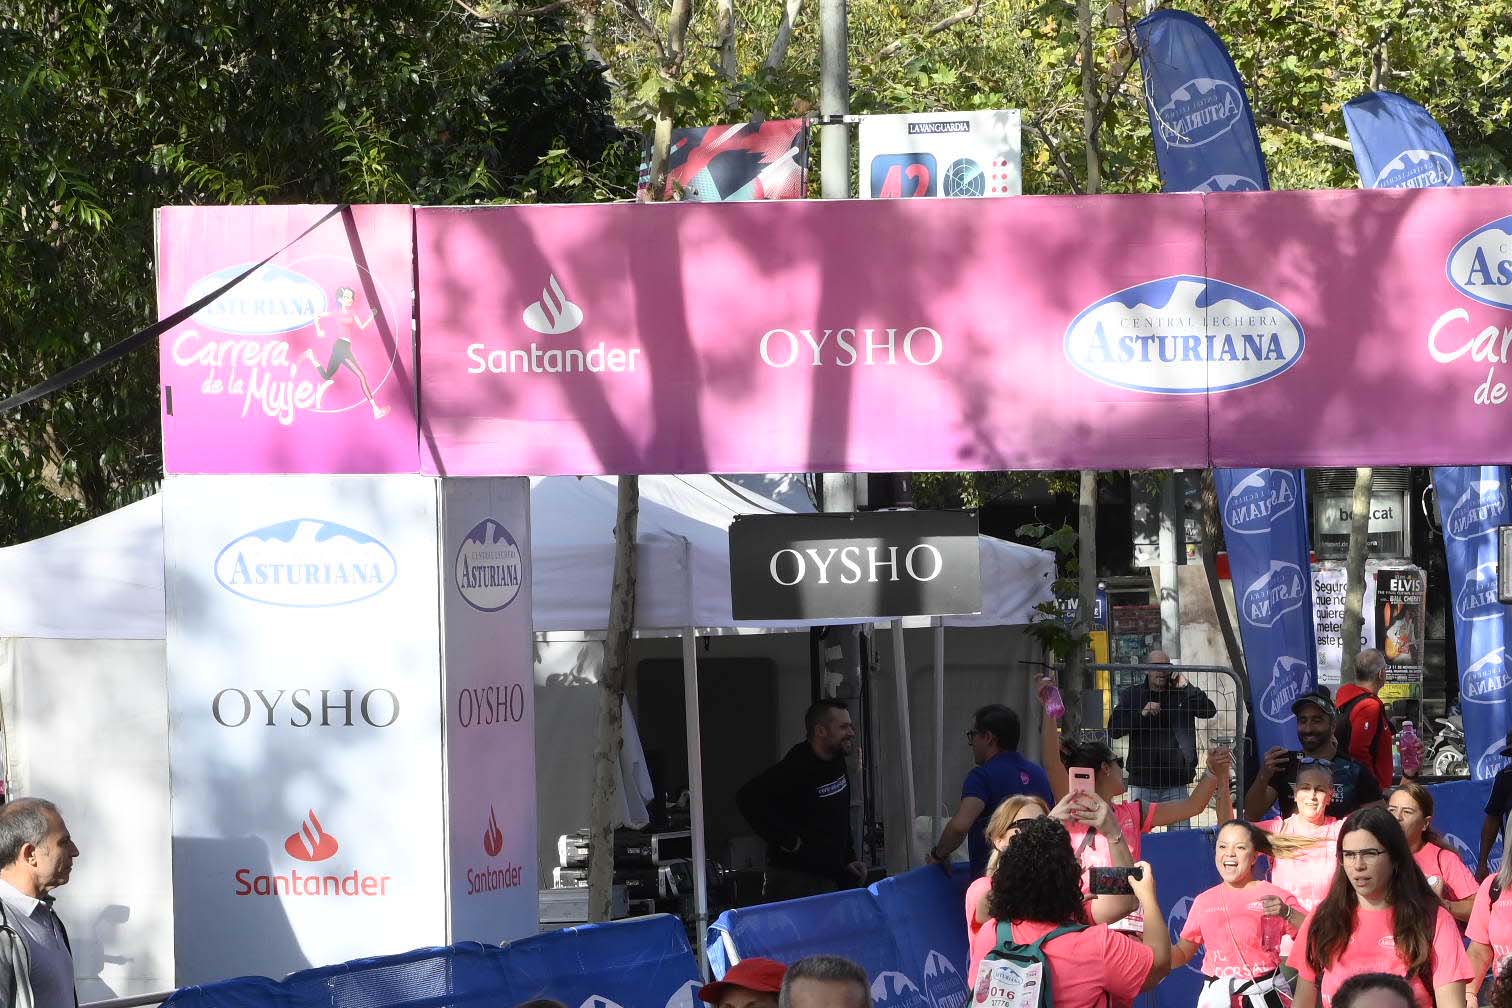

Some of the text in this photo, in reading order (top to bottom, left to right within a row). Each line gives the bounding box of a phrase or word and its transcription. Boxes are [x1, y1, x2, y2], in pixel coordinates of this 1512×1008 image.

[918, 122, 969, 133] VANGUARDIA
[1120, 315, 1279, 329] CENTRAL LECHERA
[172, 330, 289, 367] Carrera
[467, 340, 640, 374] Santander
[759, 326, 943, 368] OYSHO
[1086, 320, 1287, 363] ASTURIANA
[202, 368, 244, 395] de la
[242, 364, 334, 426] Mujer
[1474, 367, 1508, 405] de
[229, 552, 384, 586] ASTURIANA
[461, 557, 518, 590] ASTURIANA
[770, 544, 942, 586] OYSHO
[1390, 579, 1420, 592] ELVIS
[1316, 596, 1331, 609] que
[1317, 635, 1335, 645] este
[212, 687, 400, 728] OYSHO
[458, 683, 525, 728] OYSHO
[235, 868, 390, 897] Santander
[467, 862, 522, 895] Santander
[991, 986, 1016, 1000] 016
